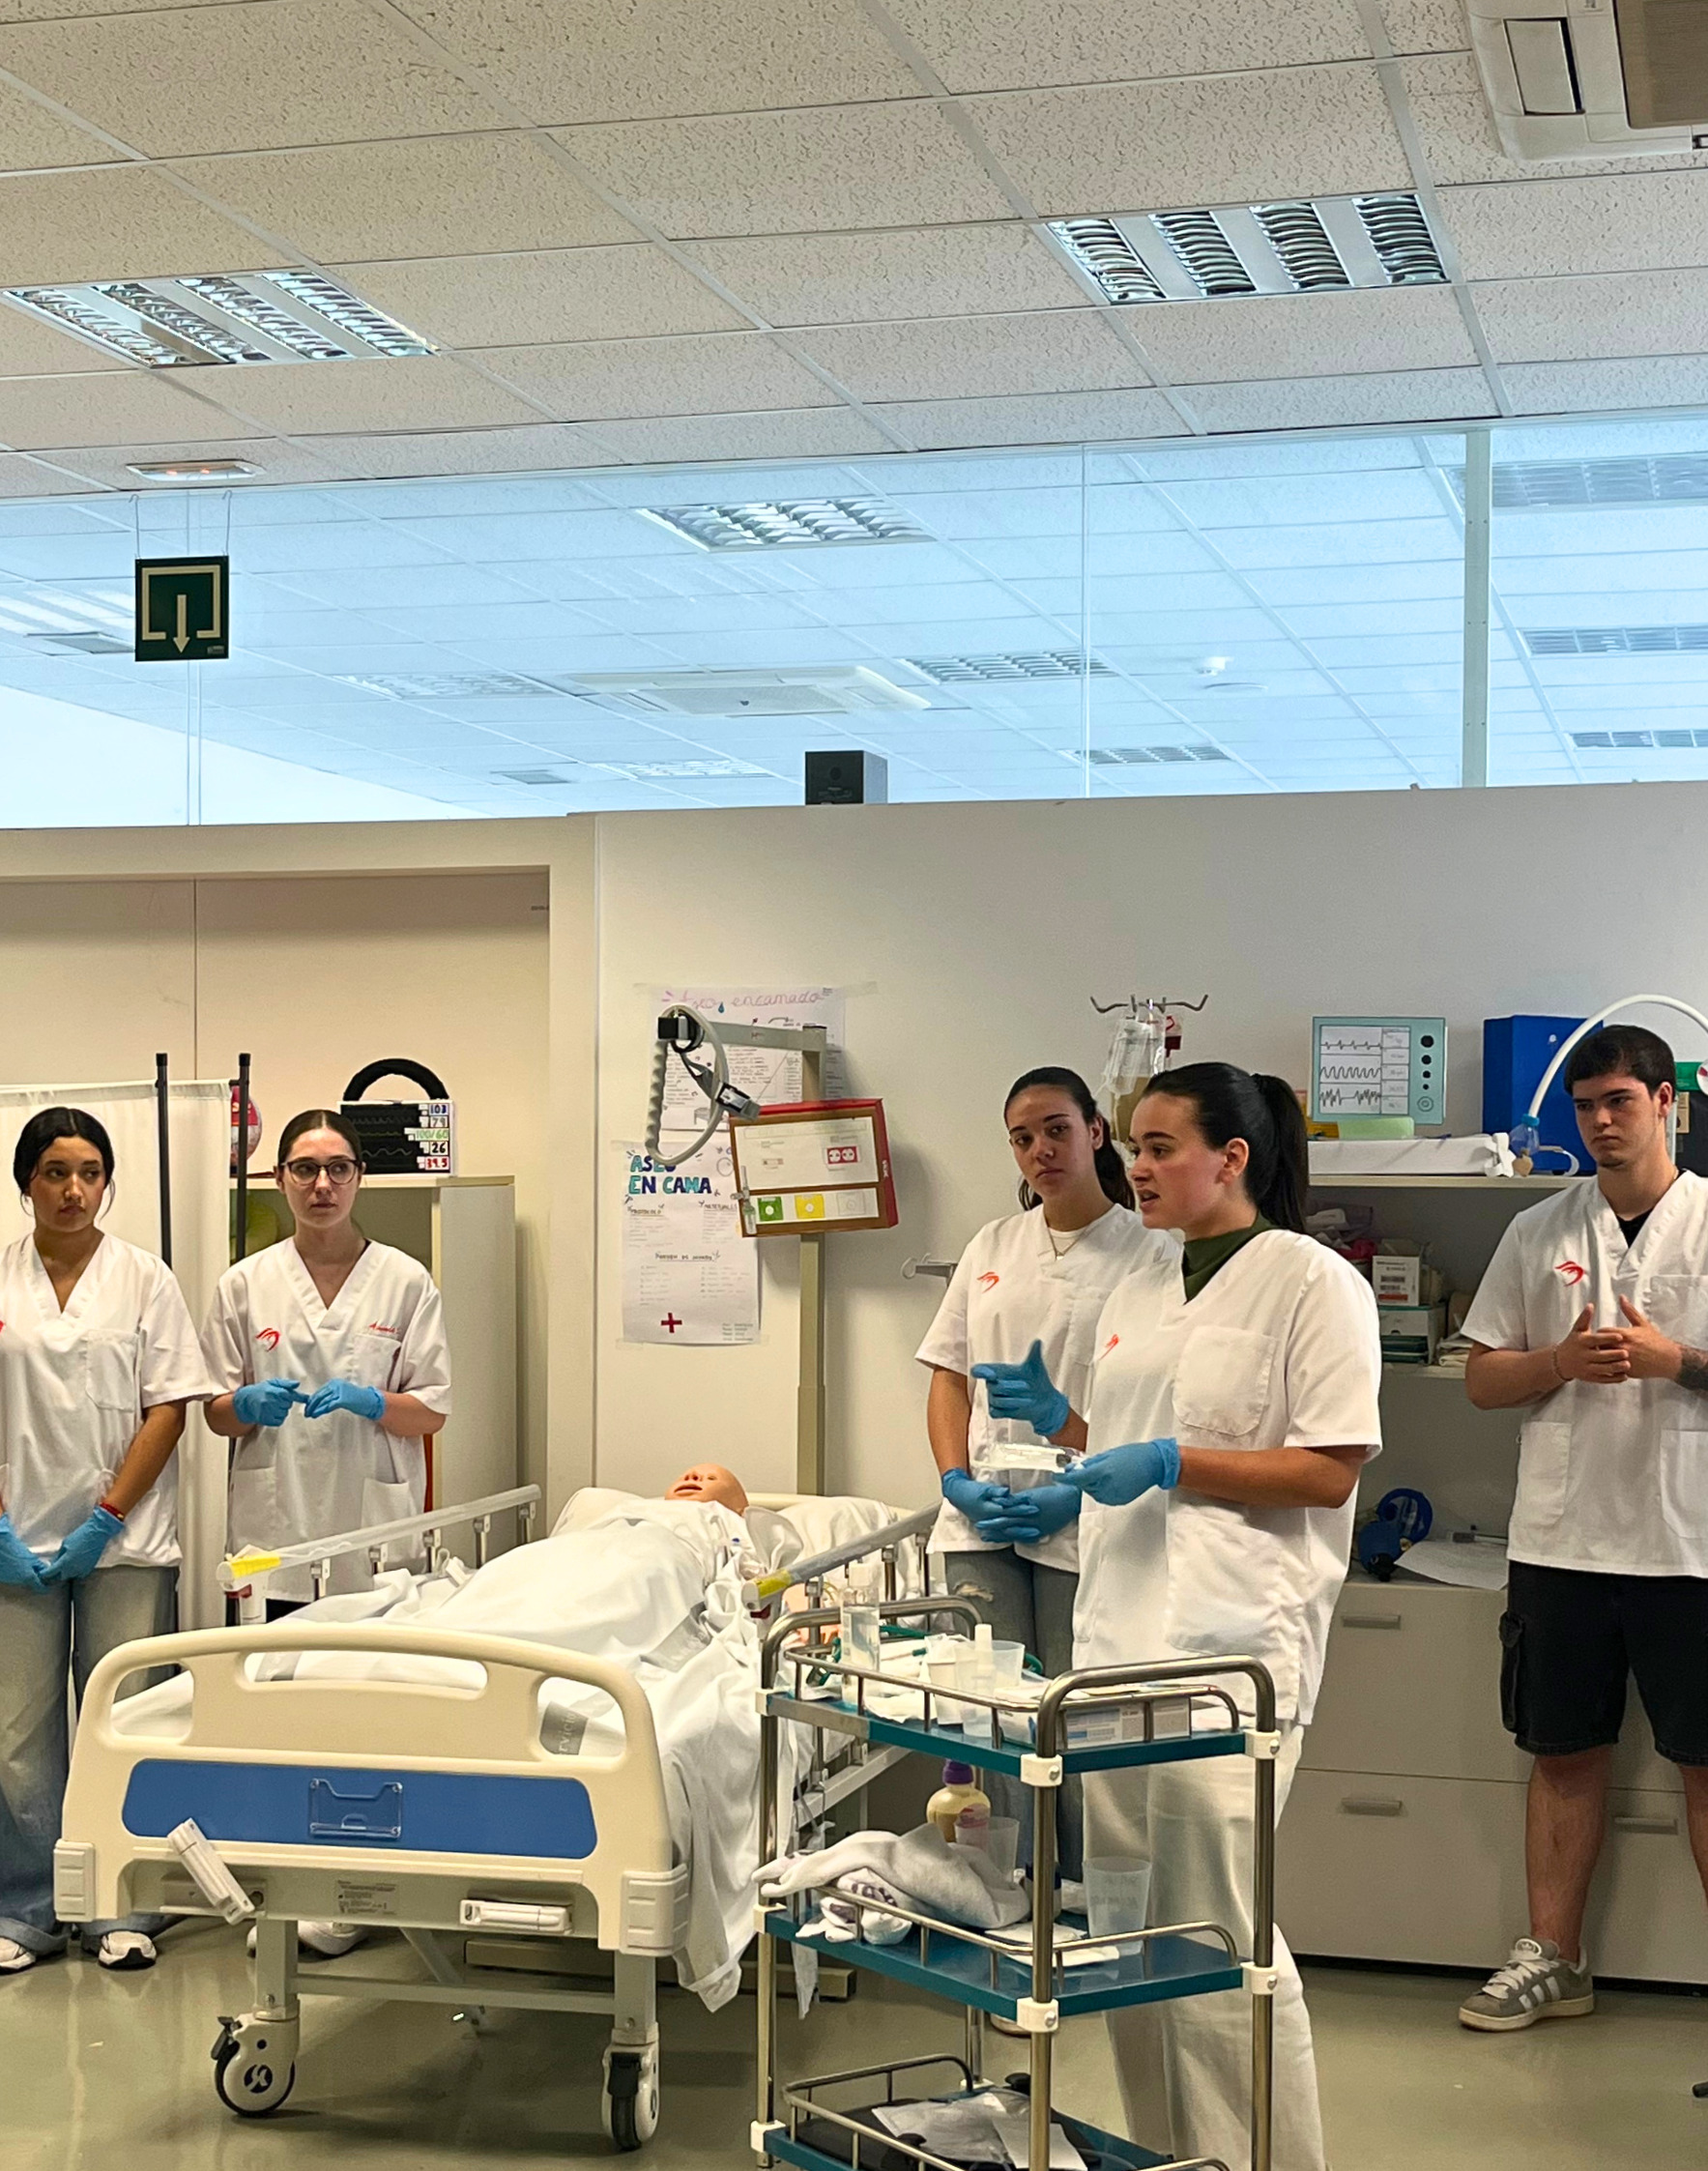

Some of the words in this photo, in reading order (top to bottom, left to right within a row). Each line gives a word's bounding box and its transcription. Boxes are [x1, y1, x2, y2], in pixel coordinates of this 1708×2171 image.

[731, 990, 825, 1007] encamado
[430, 1104, 448, 1114] 103
[431, 1142, 447, 1153] 26
[628, 1175, 656, 1195] EN
[662, 1176, 712, 1194] CAMA
